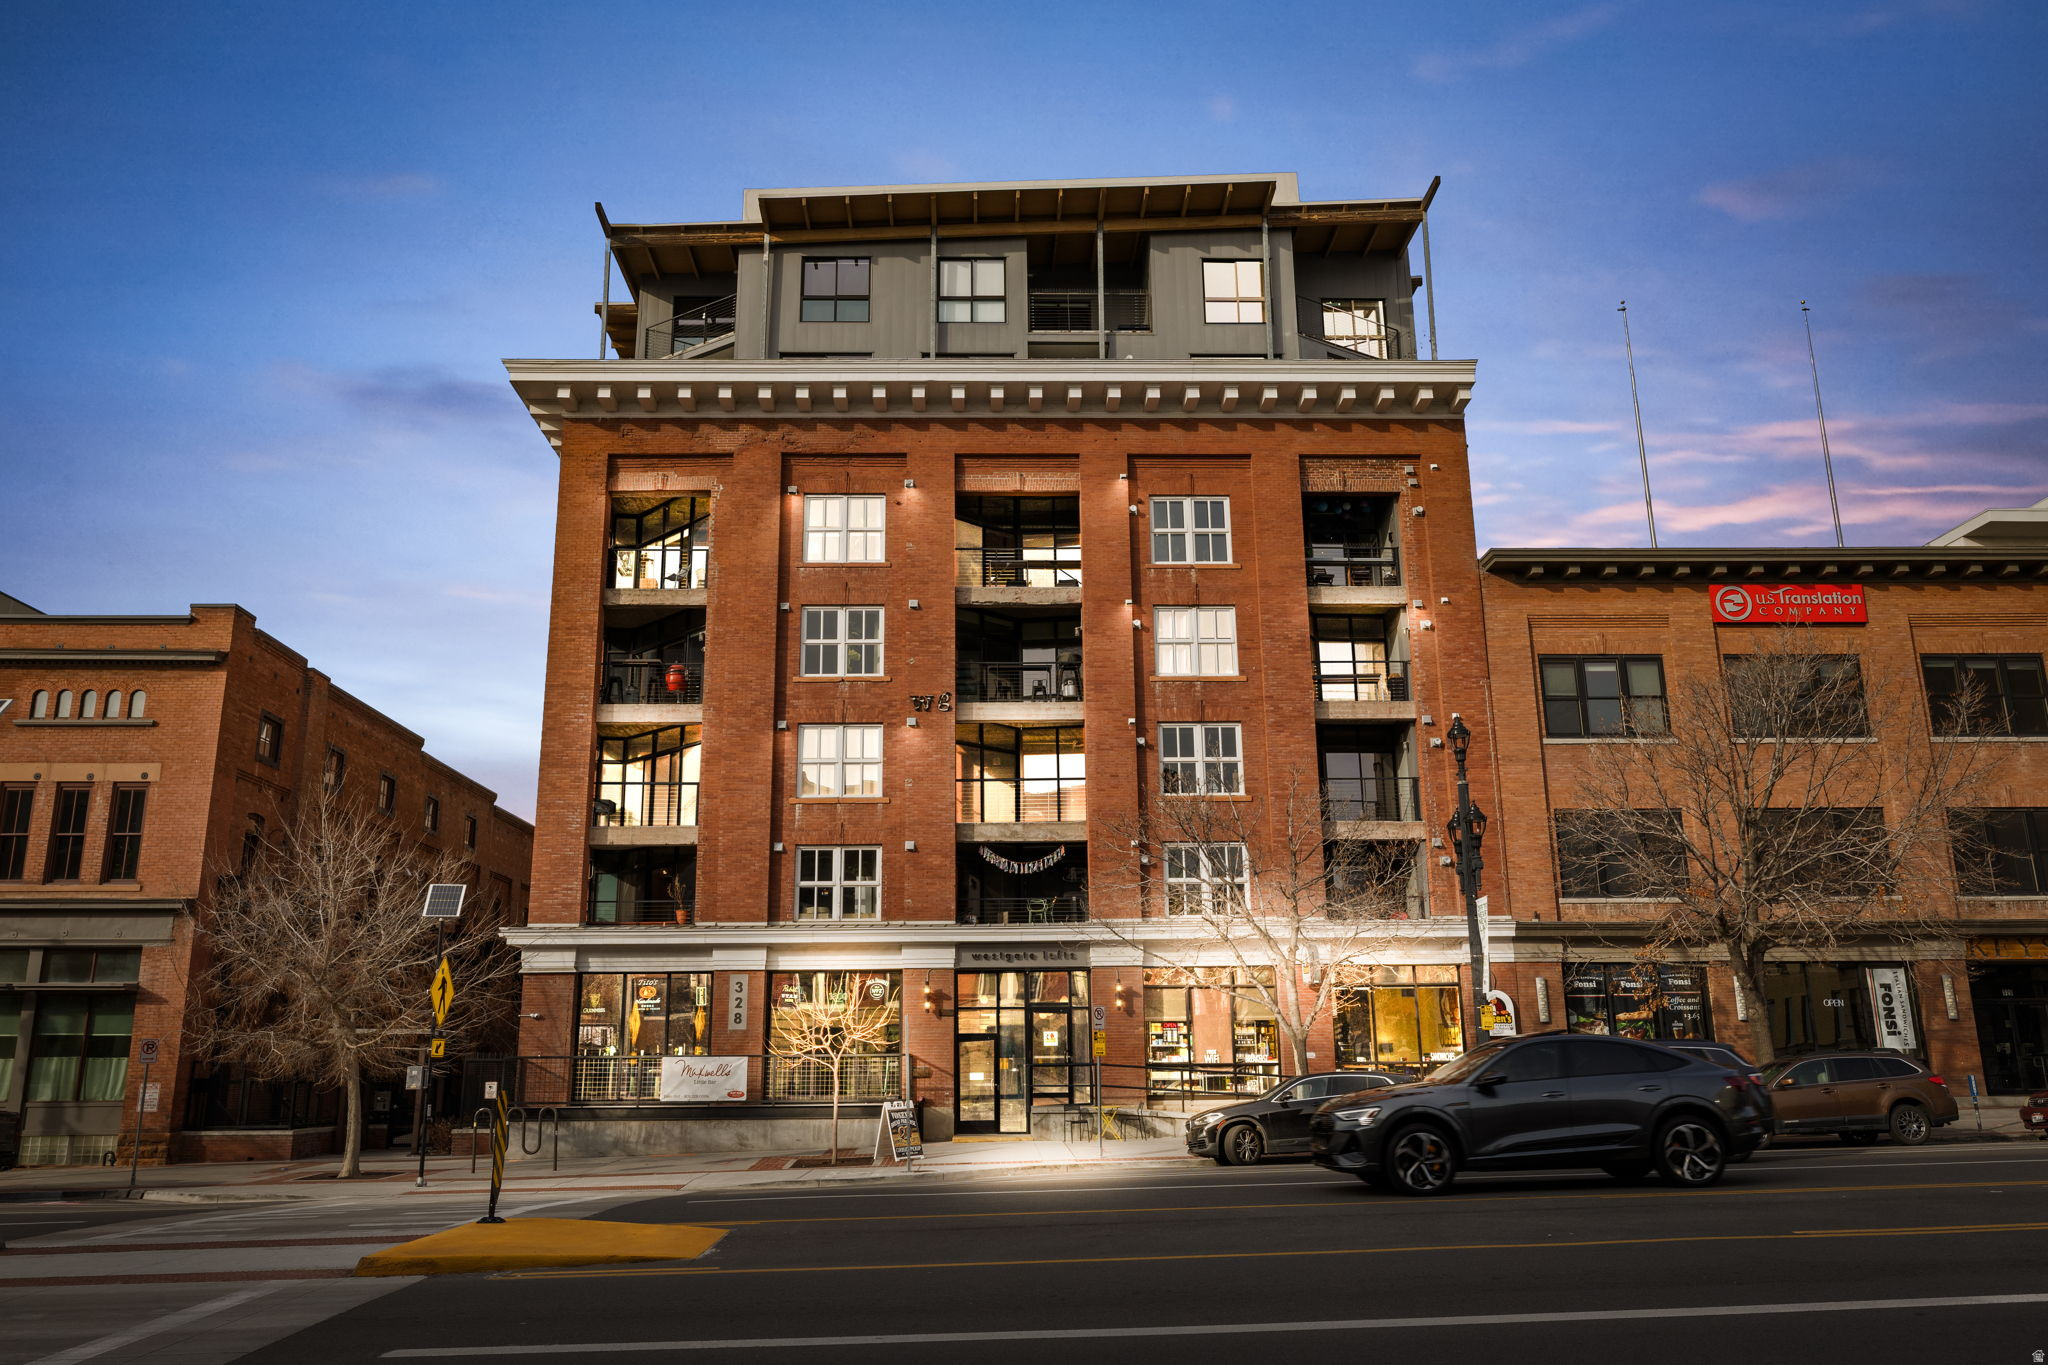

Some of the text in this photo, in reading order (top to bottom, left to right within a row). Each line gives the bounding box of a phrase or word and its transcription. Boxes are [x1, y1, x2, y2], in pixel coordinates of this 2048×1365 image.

[1769, 586, 1862, 605] Translation
[1759, 606, 1857, 616] COMPANY
[971, 950, 1078, 963] westgate lofts
[1573, 980, 1597, 988] Fonsi
[1620, 980, 1643, 988] Fonsi
[1668, 978, 1692, 986] Fonsi
[1666, 995, 1686, 1004] Coffee
[1823, 998, 1845, 1007] OPEN
[1668, 1003, 1700, 1011] Croissant
[1892, 970, 1910, 1047] ITALIAN SANDWICHES
[674, 1059, 733, 1079] Maxwell's
